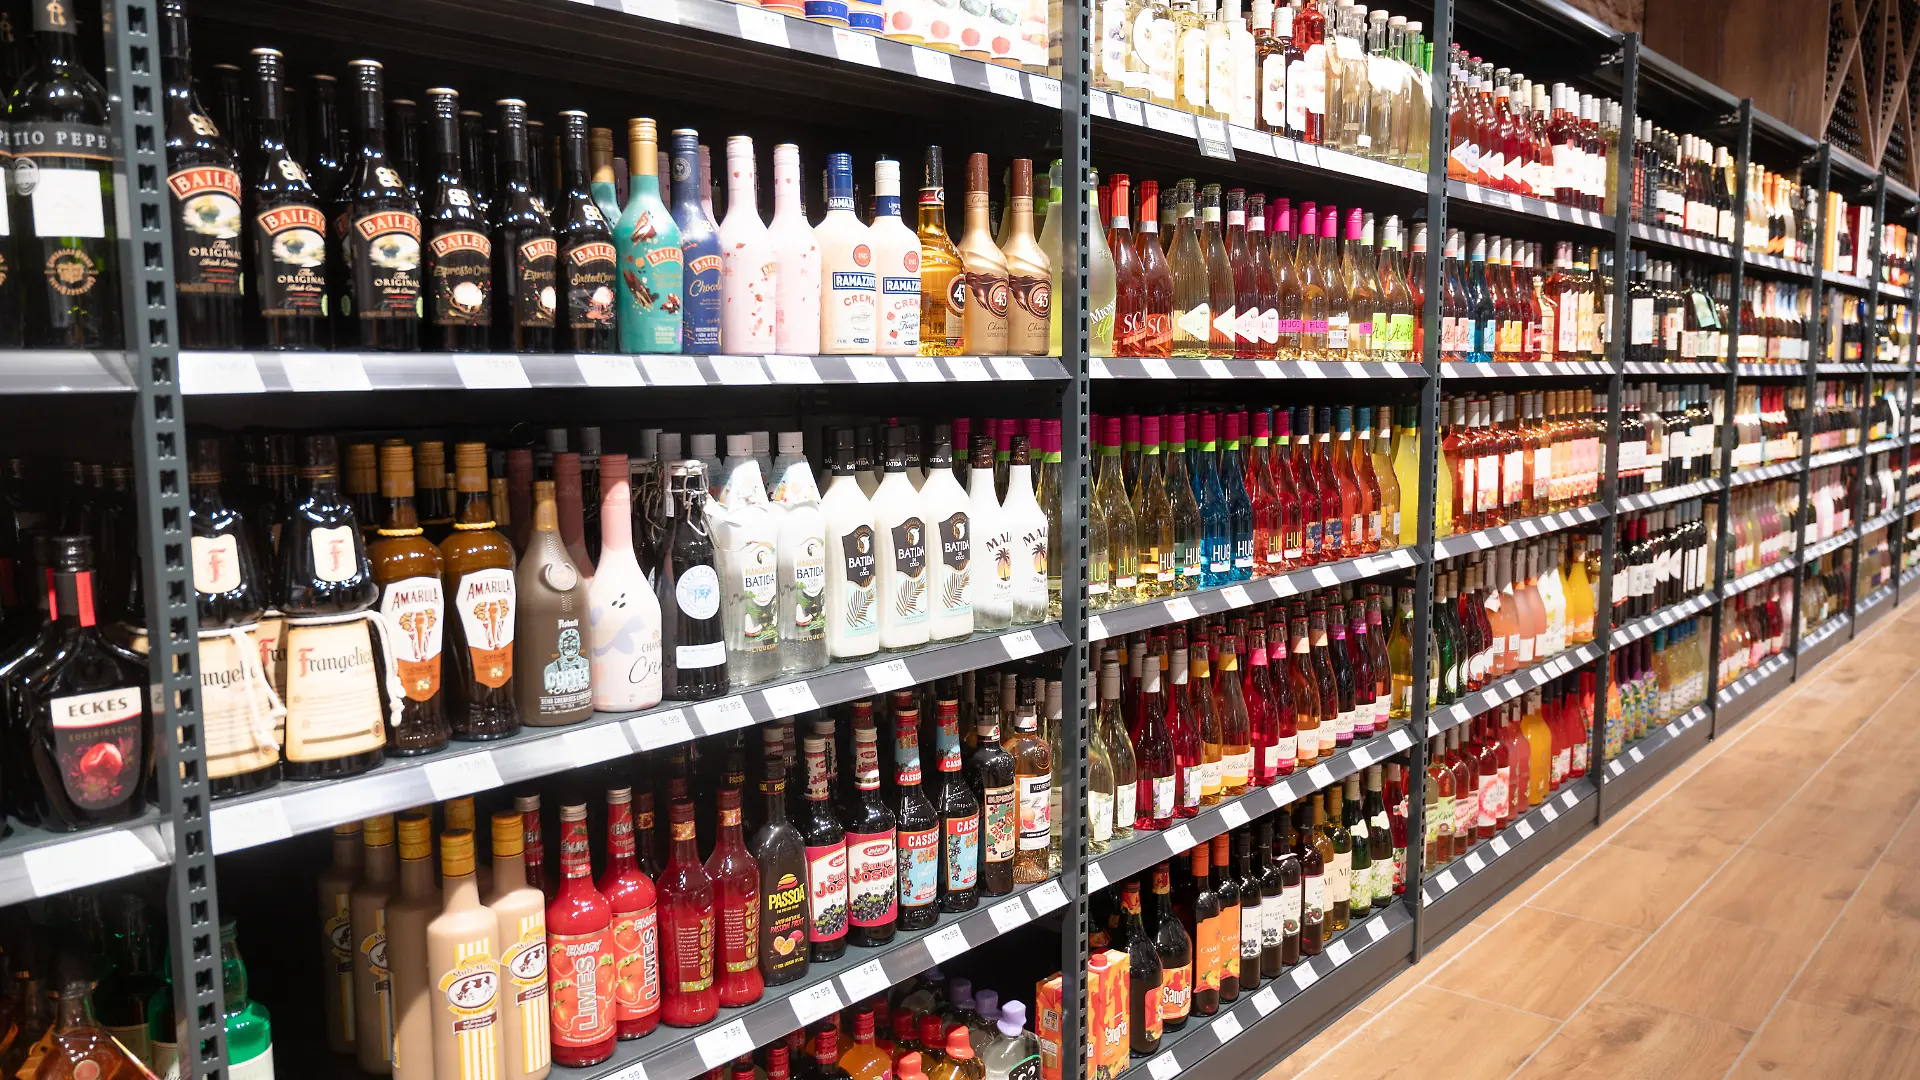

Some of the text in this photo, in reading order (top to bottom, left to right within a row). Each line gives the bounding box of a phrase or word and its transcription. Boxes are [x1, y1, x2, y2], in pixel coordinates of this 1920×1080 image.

[55, 131, 108, 149] PEPE
[894, 298, 920, 310] CREM
[1034, 292, 1049, 308] 43
[1123, 311, 1147, 334] SCA
[944, 540, 970, 552] BATIDA
[1268, 535, 1282, 552] HU
[848, 555, 874, 568] BATIDA
[898, 546, 925, 560] BATIDA
[745, 574, 775, 588] BATIDA
[796, 566, 825, 579] BATIDA
[392, 587, 439, 612] AMARULA
[466, 579, 513, 602] AMARULA
[68, 697, 128, 718] ECKES
[956, 816, 979, 833] CASS
[908, 829, 939, 847] CASSIS
[566, 939, 602, 957] ENJOY
[644, 926, 658, 1000] LIMES
[576, 954, 599, 1032] LIMES
[1162, 983, 1191, 1007] Sangria
[1104, 1020, 1127, 1047] Sangria
